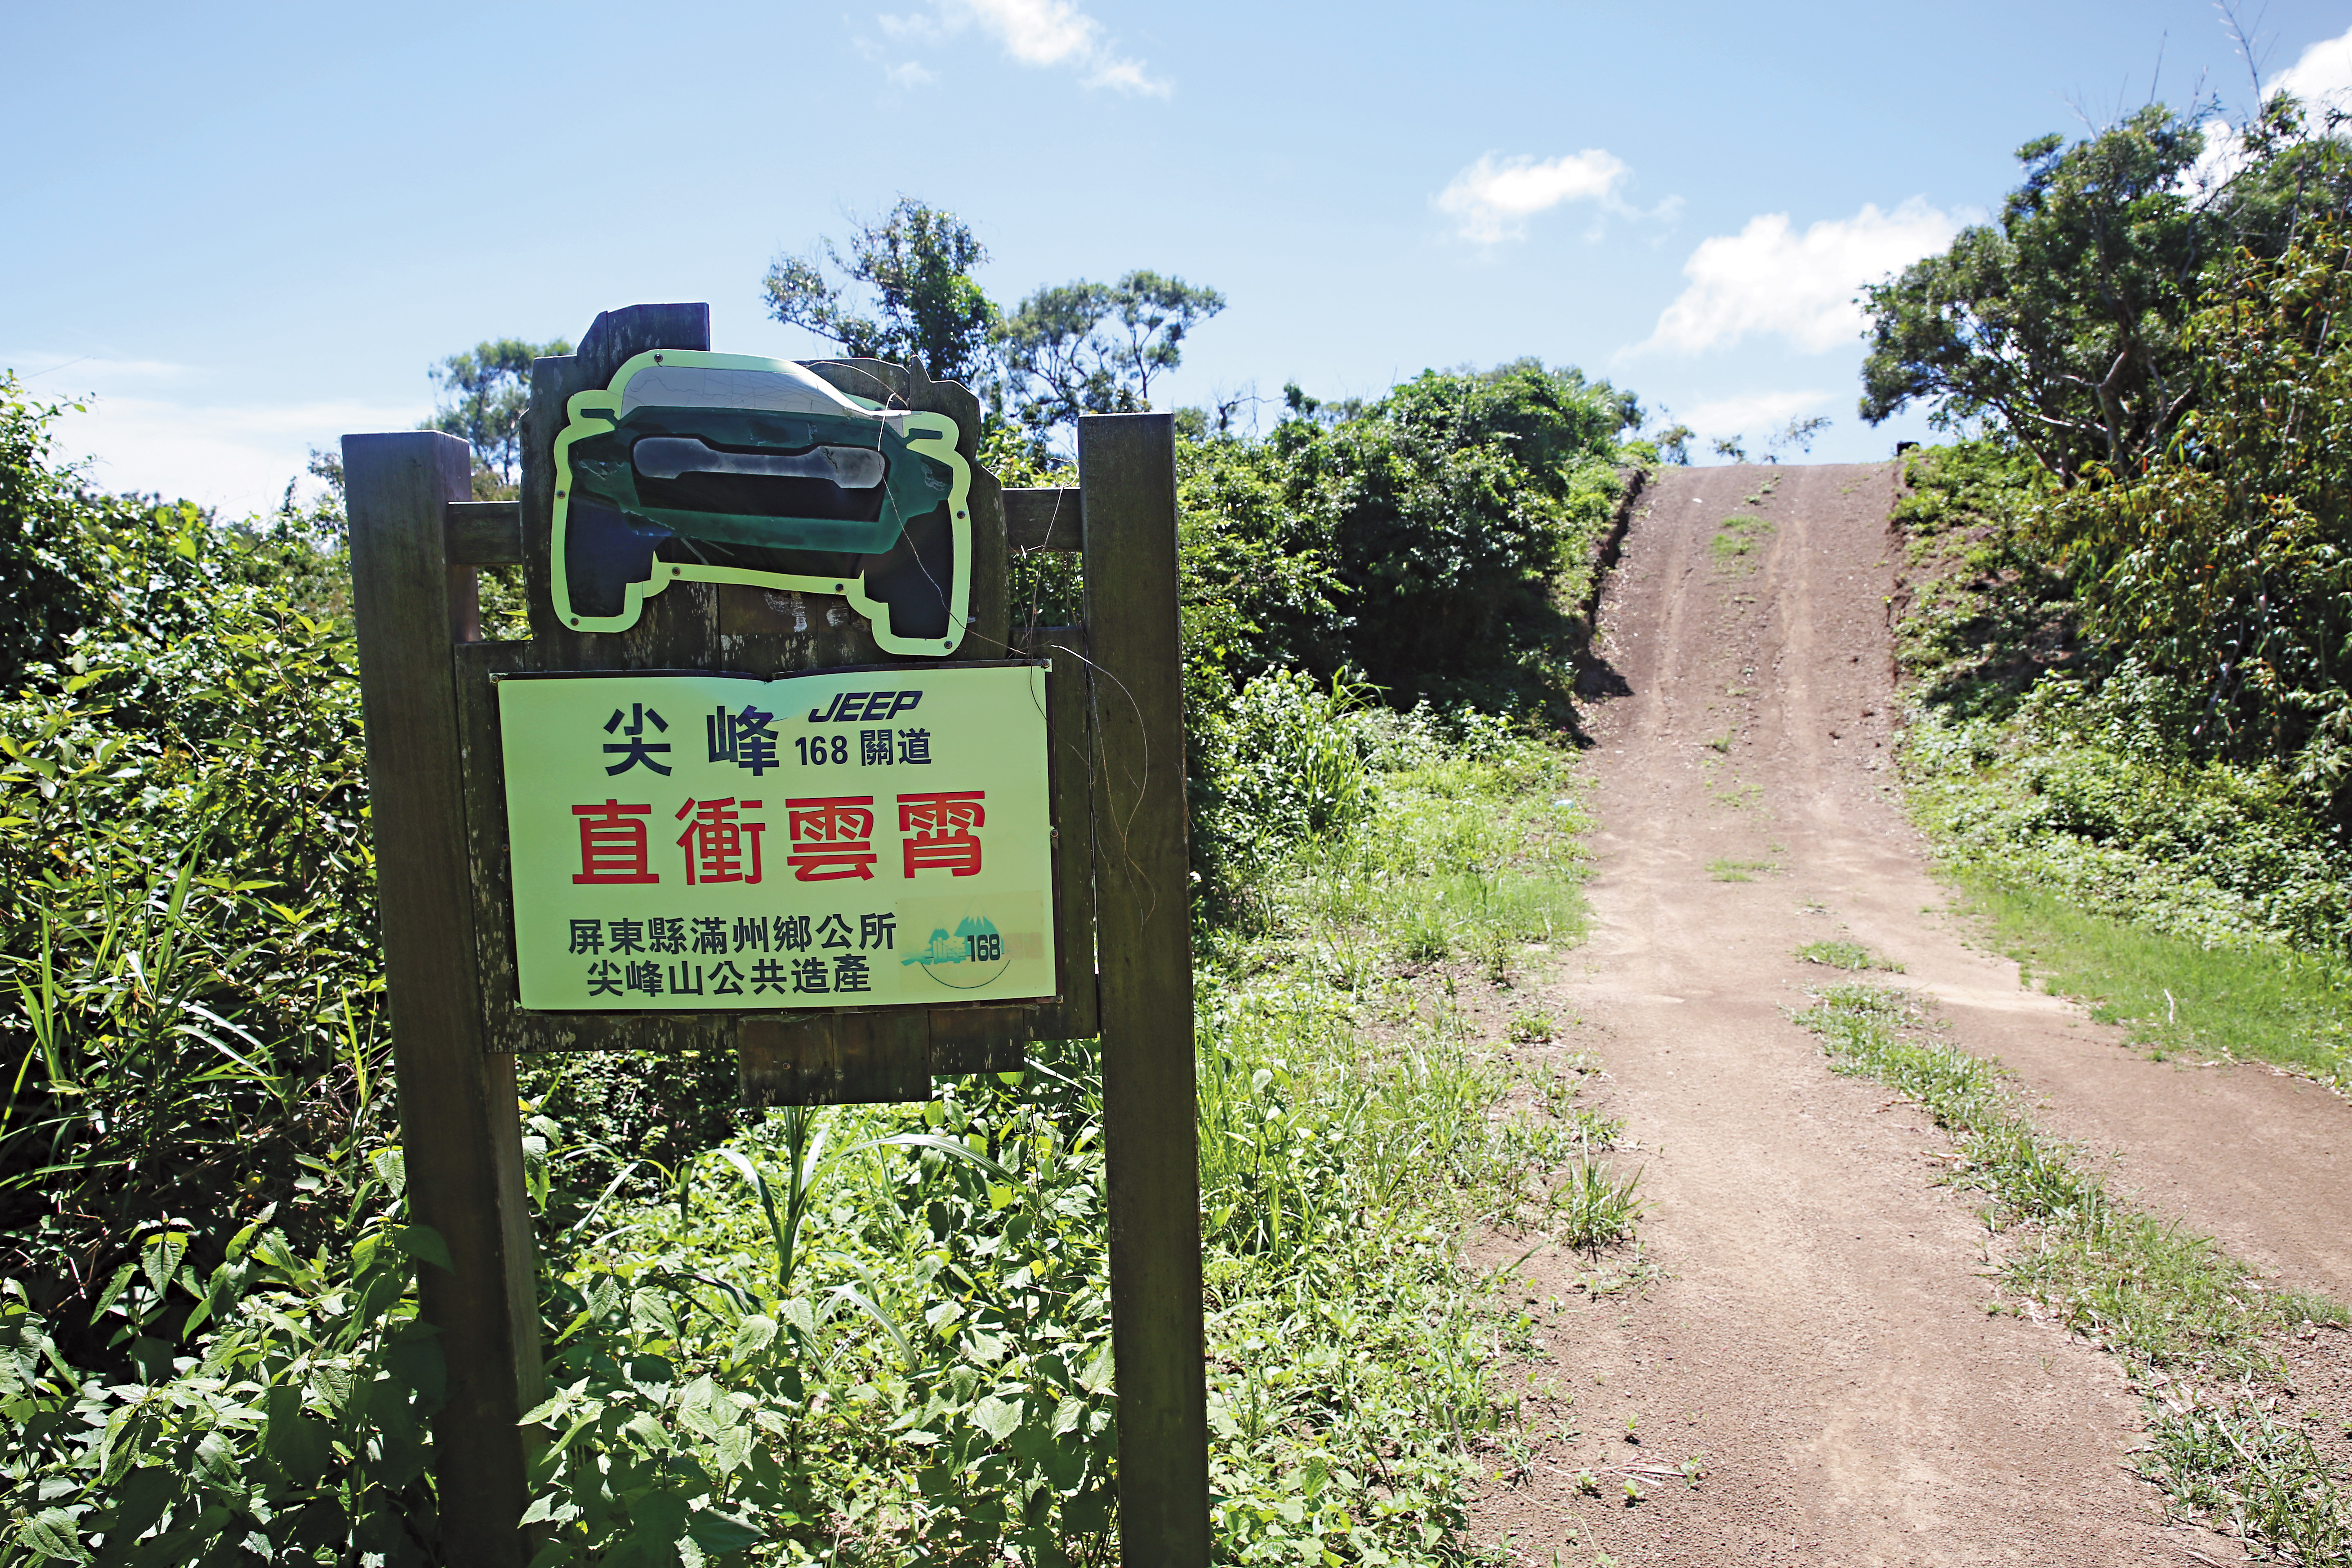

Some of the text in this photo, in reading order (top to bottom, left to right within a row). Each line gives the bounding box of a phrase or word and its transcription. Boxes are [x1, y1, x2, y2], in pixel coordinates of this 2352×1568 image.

[808, 690, 923, 723] JEEP
[603, 703, 780, 777] 尖峰
[795, 728, 932, 766] 168 關道
[572, 791, 985, 885] 直衝雲霄
[568, 912, 896, 956] 屏東縣滿州鄉公所
[967, 933, 1000, 962] 168
[587, 953, 871, 997] 尖峰山公共造產
